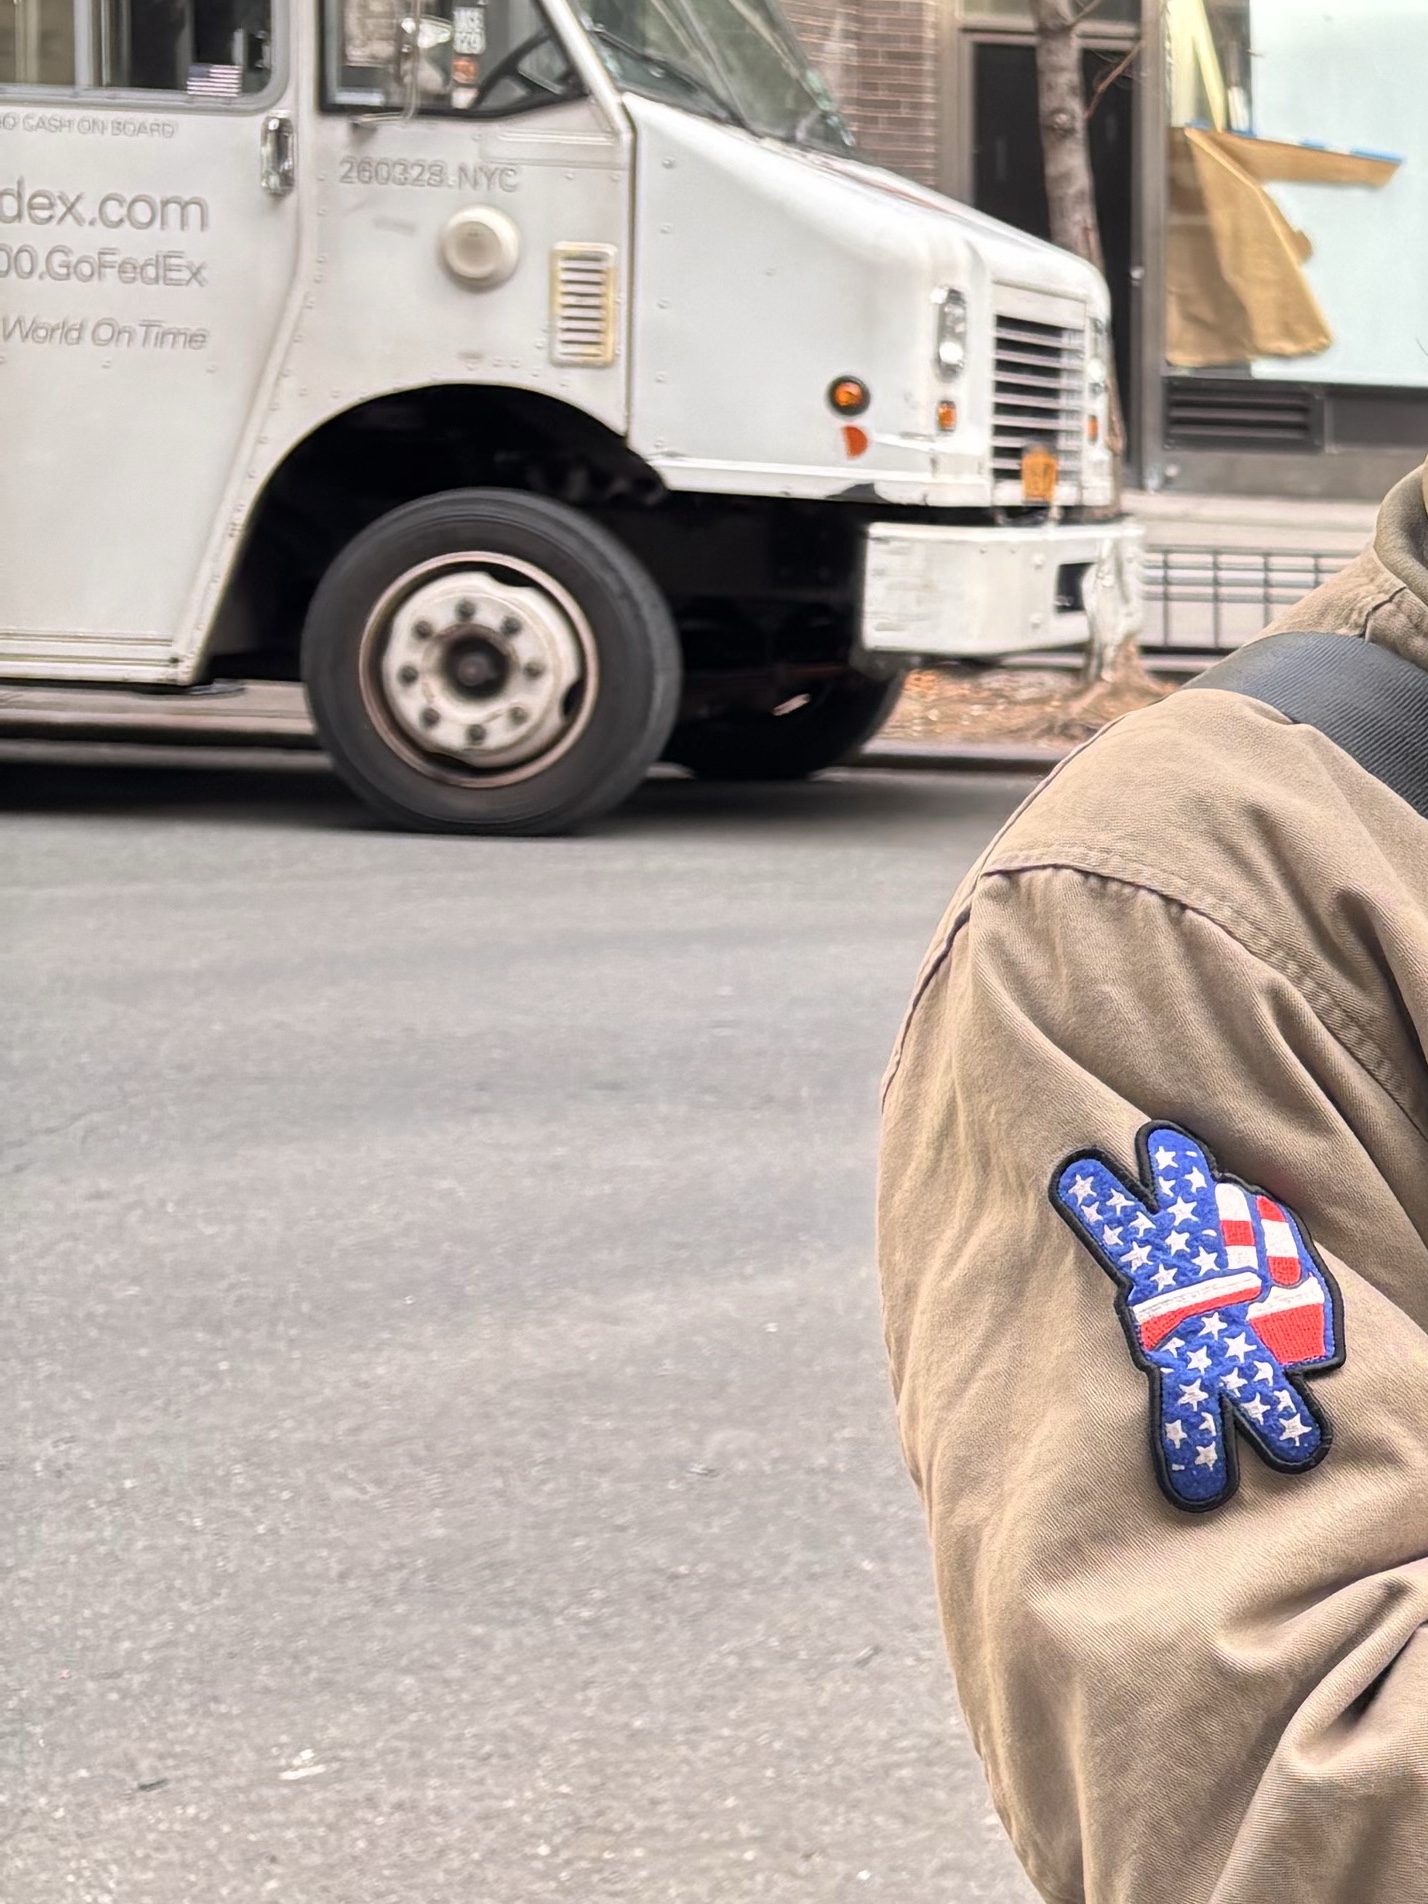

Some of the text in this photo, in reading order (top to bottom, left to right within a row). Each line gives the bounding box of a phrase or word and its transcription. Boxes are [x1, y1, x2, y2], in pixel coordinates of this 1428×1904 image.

[22, 115, 73, 133] CASH
[77, 117, 107, 136] ON
[110, 119, 177, 138] BOARD
[0, 174, 209, 232] dex.com
[2, 315, 208, 351] World On Time
